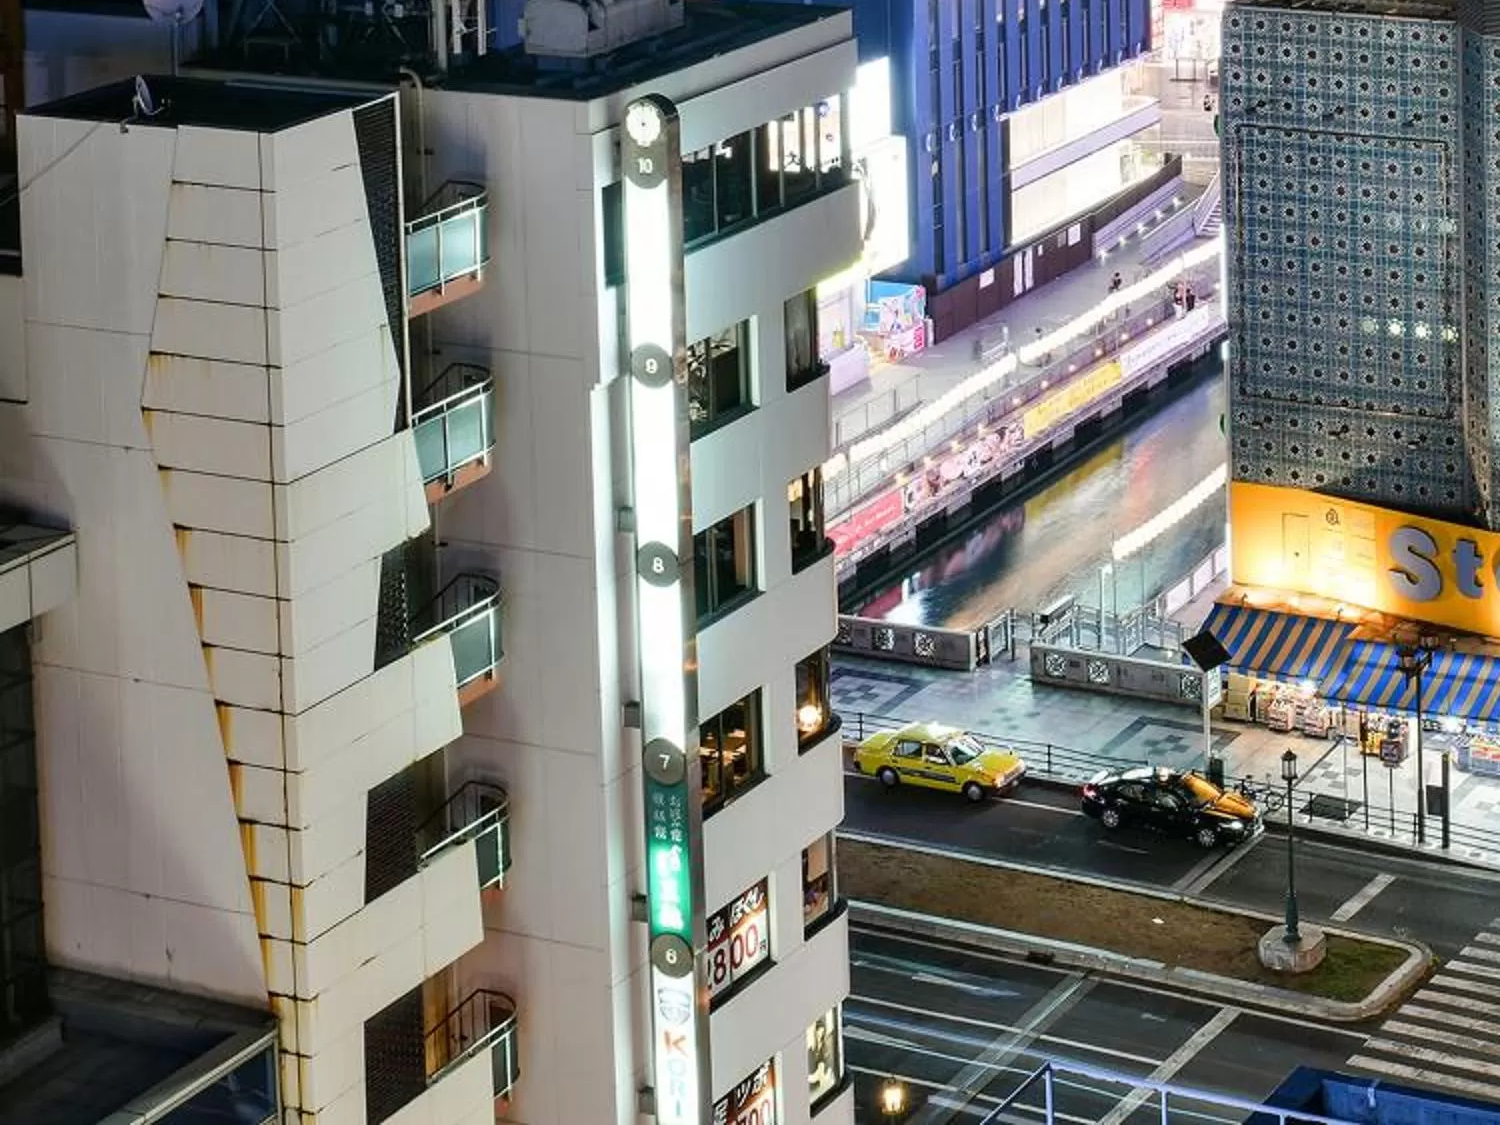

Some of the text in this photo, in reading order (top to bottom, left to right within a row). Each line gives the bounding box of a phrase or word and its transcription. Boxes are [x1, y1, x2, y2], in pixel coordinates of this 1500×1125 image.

[638, 157, 653, 174] 10
[645, 358, 657, 374] 9
[653, 557, 665, 573] 8
[658, 755, 670, 770] 7
[664, 948, 678, 964] 6
[708, 923, 768, 990] 800円
